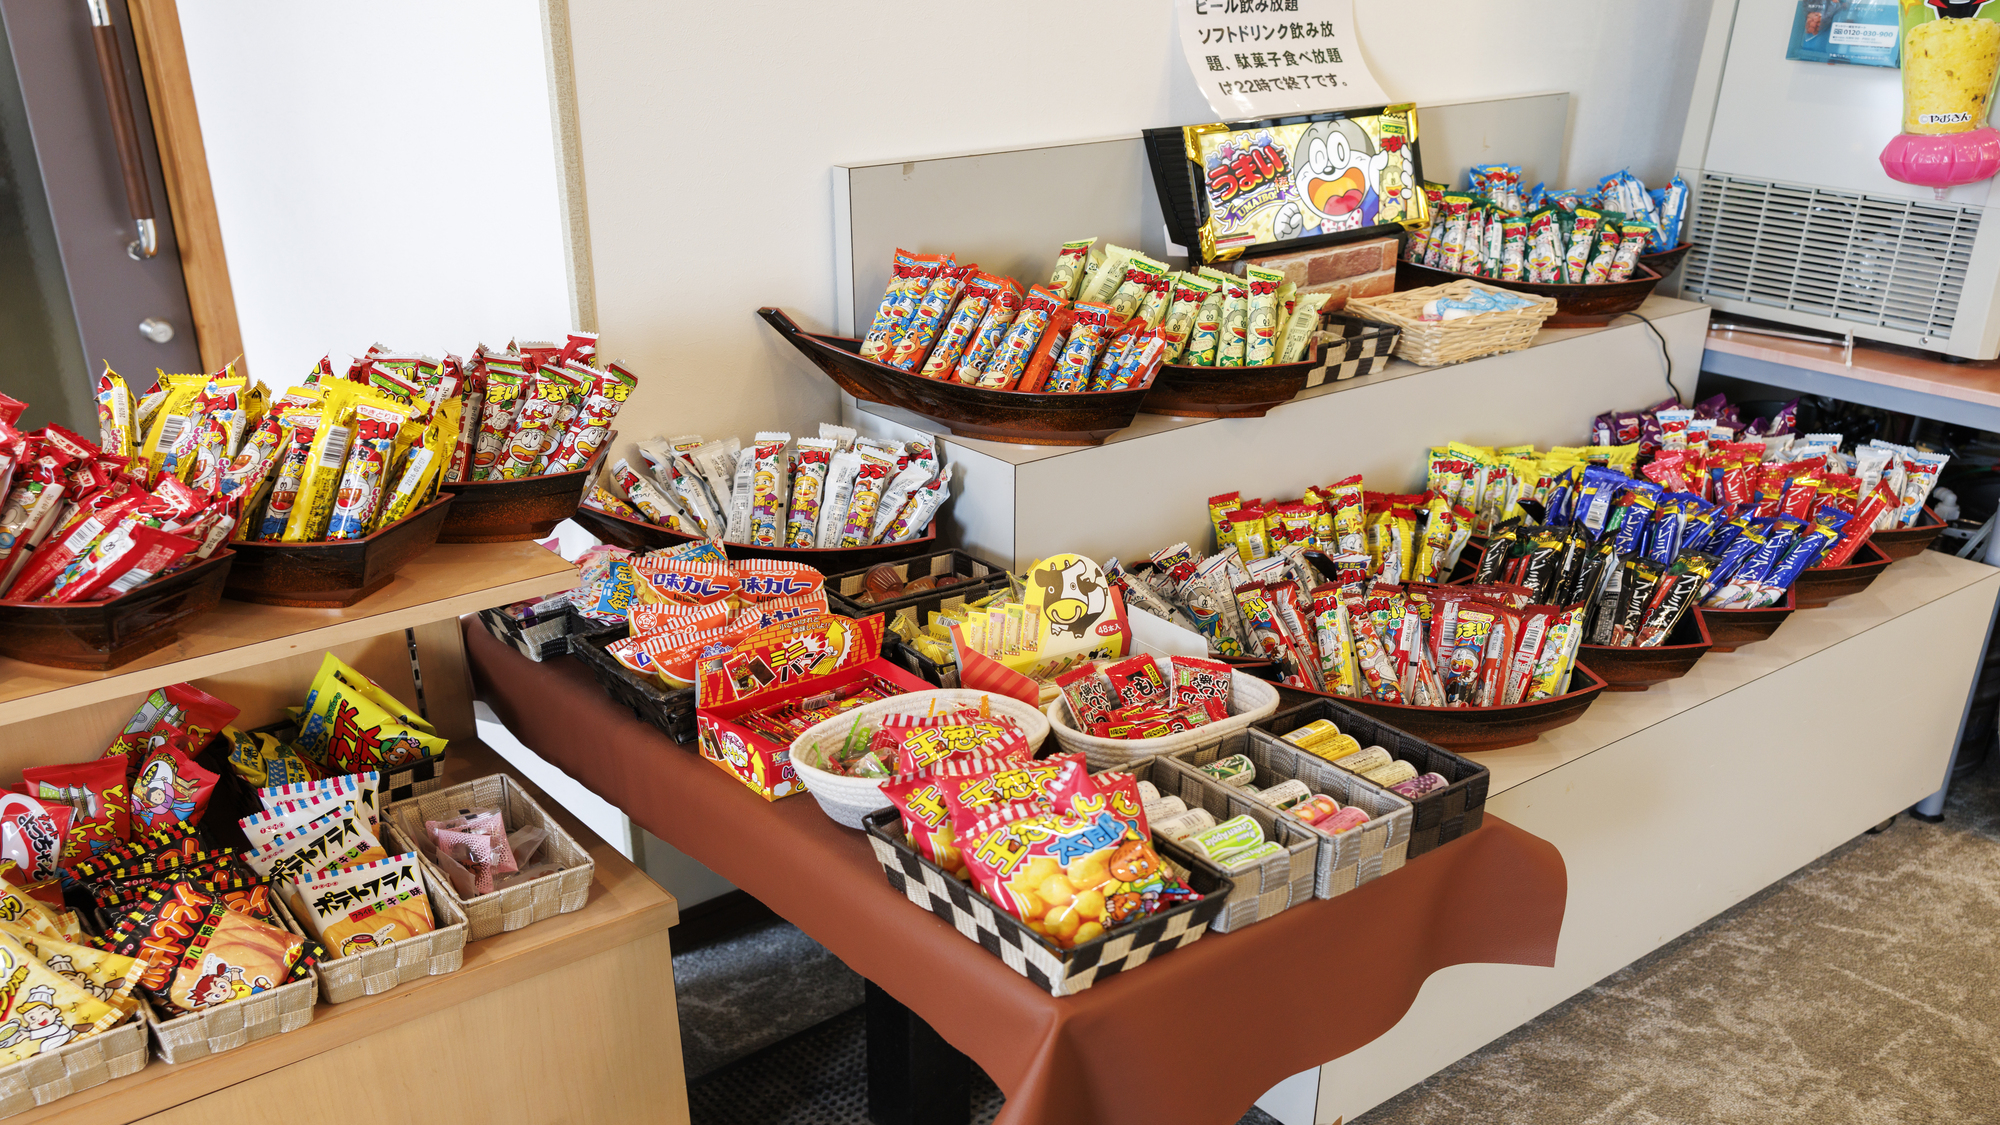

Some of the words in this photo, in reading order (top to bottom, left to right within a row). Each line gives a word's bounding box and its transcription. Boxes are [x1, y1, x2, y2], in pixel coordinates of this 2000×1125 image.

[1195, 0, 1299, 15] ビール飲み放題
[1198, 20, 1336, 44] ソフトドリンク飲み放
[1843, 29, 1894, 38] 0120-030-900
[1205, 47, 1344, 72] 題、駄菓子食べ放題
[1218, 72, 1348, 96] は22時で終了です。
[1208, 144, 1286, 202] うまい
[1273, 175, 1289, 193] 棒
[1236, 190, 1279, 219] UMAIBO!
[602, 382, 635, 403] うま
[359, 405, 401, 422] やきとり味
[356, 417, 400, 441] まい
[652, 573, 731, 597] 味カレー
[1242, 596, 1269, 620] まい
[1314, 595, 1338, 618] まい
[779, 615, 821, 631] 小さいけれど
[1097, 622, 1123, 635] 48本入
[1047, 811, 1129, 867] 太郎
[1224, 820, 1254, 841] Green
[17, 813, 58, 881] よっちゃん
[268, 816, 361, 889] ポテトフライ
[125, 876, 153, 888] TOHO
[311, 880, 340, 891] TOHO
[311, 864, 416, 919] ポテトフライ
